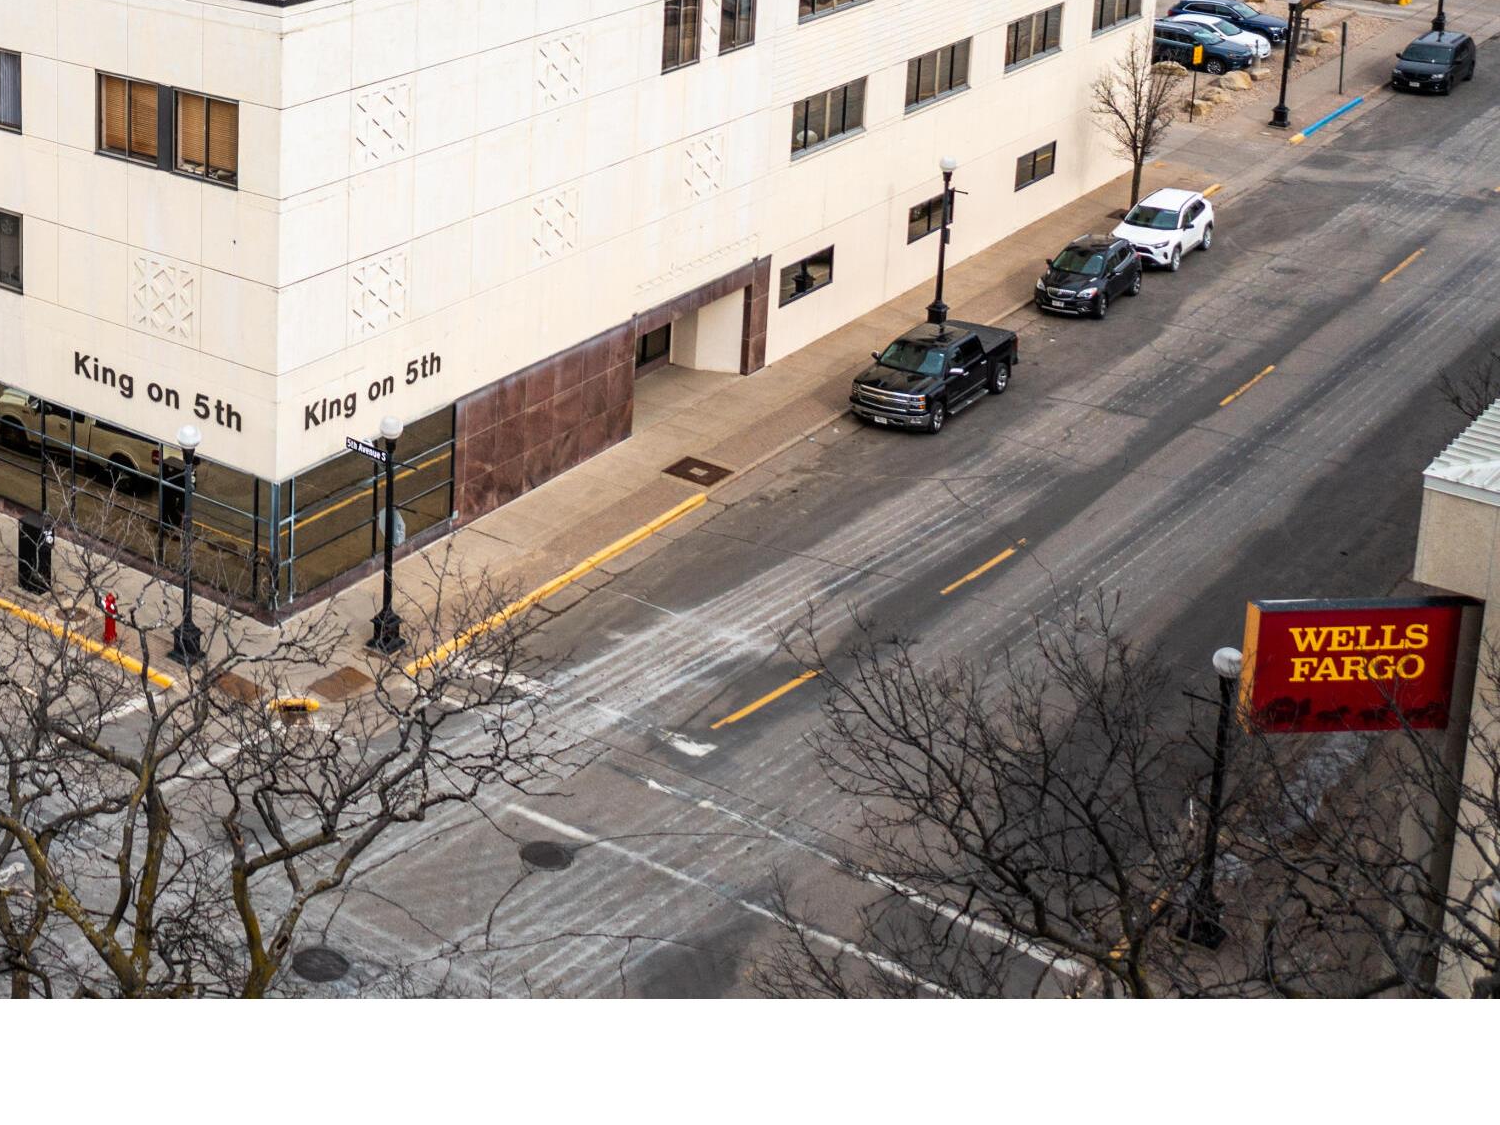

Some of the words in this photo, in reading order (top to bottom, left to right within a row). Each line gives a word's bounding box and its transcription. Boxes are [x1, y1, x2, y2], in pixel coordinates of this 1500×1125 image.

[74, 351, 135, 399] King
[147, 382, 180, 410] on
[193, 393, 242, 432] 5th
[304, 392, 357, 431] King
[368, 374, 395, 402] on
[405, 351, 442, 386] 5th
[347, 438, 358, 451] 5th
[358, 443, 381, 460] Avenue
[381, 452, 387, 462] S
[1288, 623, 1429, 652] WELLS
[1288, 653, 1426, 682] FARGO
